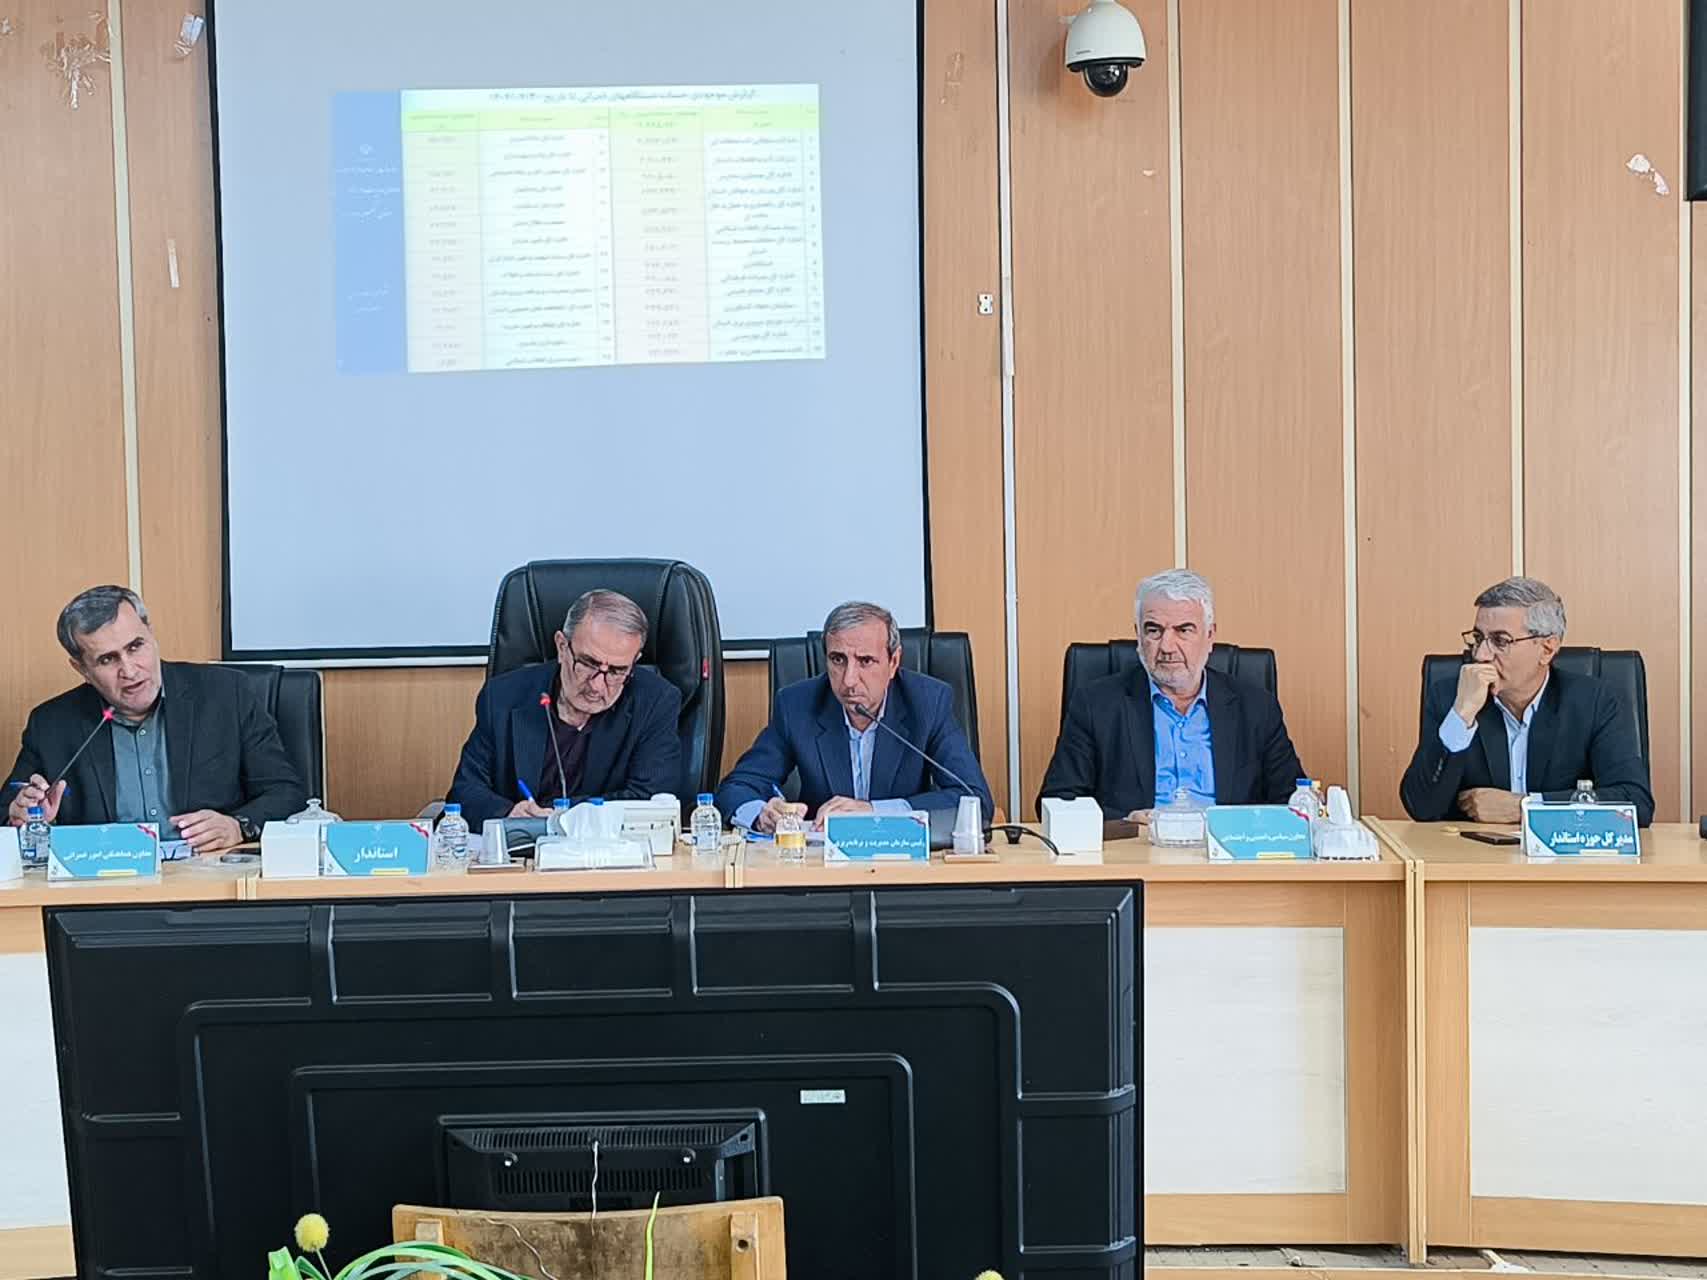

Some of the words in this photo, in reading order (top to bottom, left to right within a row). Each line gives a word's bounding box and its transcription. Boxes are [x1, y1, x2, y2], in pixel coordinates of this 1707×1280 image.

[1549, 831, 1580, 847] استاندار
[1580, 833, 1601, 847] حوزه
[1601, 831, 1614, 847] کل
[1615, 832, 1634, 847] مدیر
[353, 846, 399, 863] استاندار
